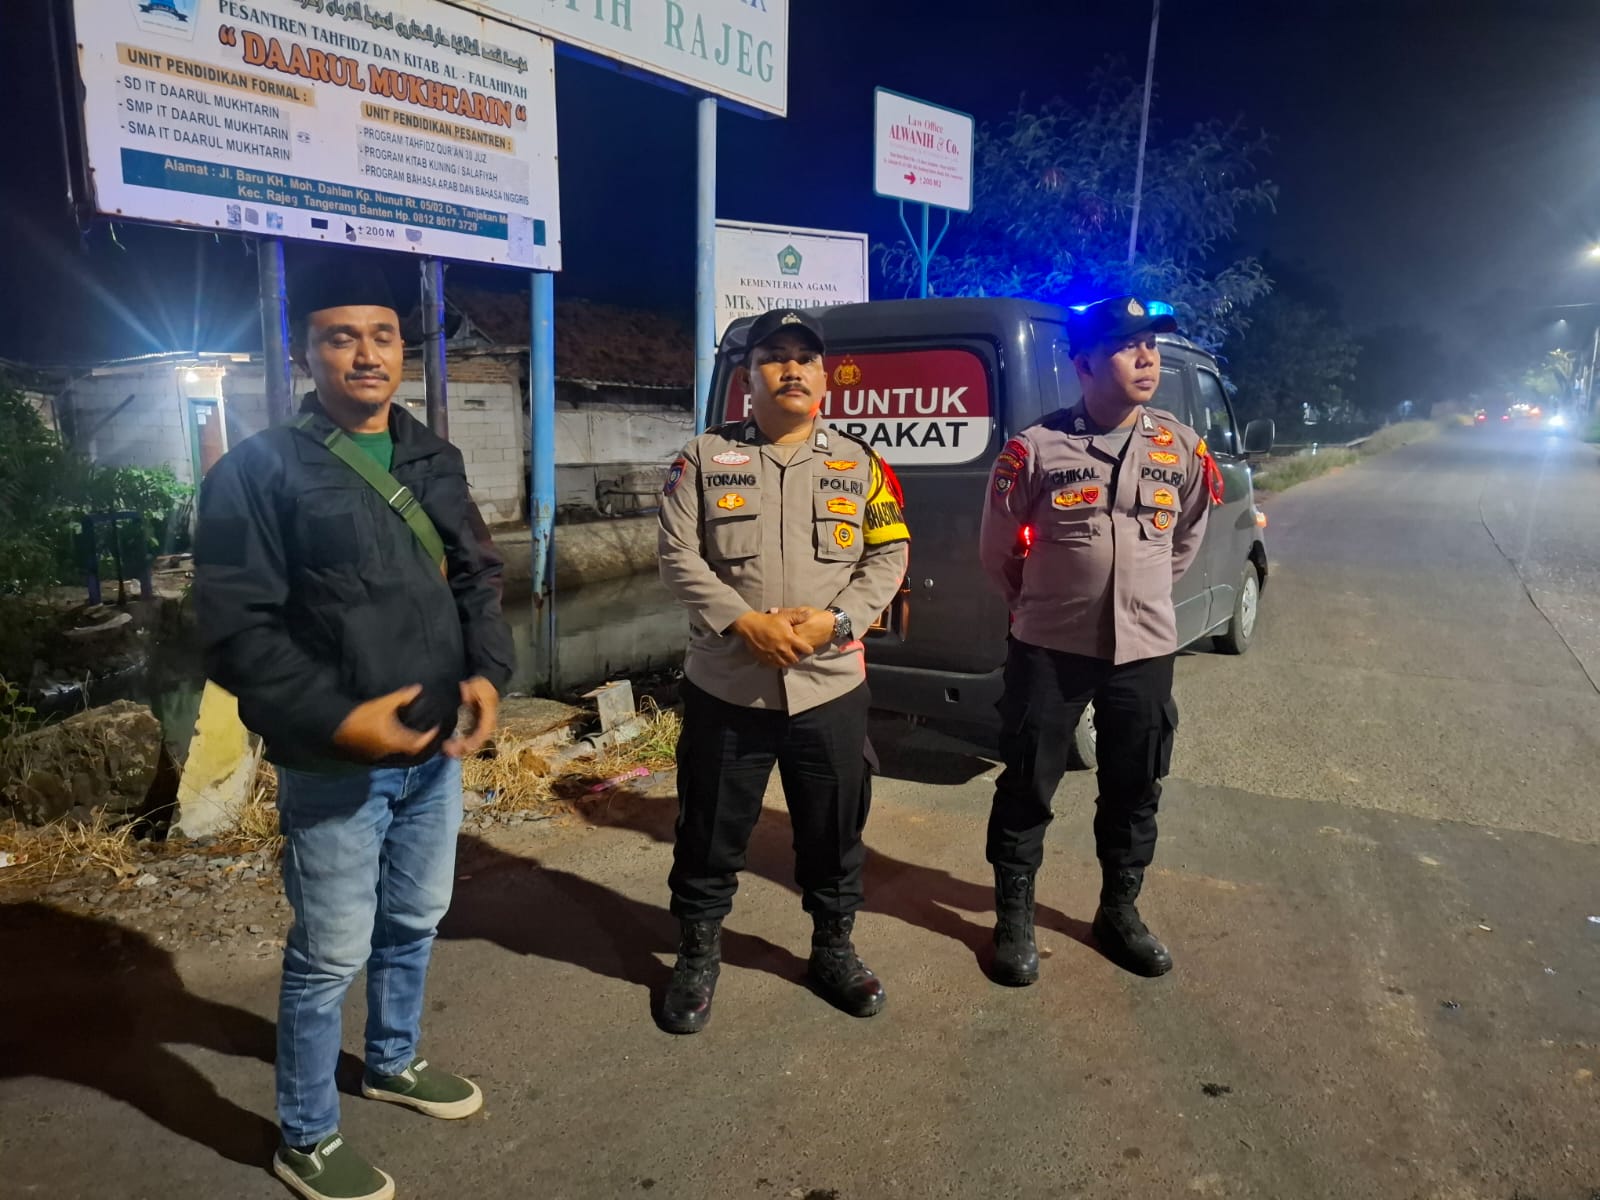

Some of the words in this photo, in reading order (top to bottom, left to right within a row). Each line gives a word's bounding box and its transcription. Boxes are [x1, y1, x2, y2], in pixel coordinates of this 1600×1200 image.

[219, 0, 306, 36] PESANTREN
[311, 26, 368, 54] TAHFIDZ
[373, 44, 400, 62] DAN
[404, 52, 439, 74] KITAB
[443, 65, 457, 79] AL
[469, 72, 527, 99] FALAHIYAH
[664, 0, 774, 83] RAJEG
[127, 48, 161, 68] UNIT
[167, 59, 247, 91] PENDIDIKAN
[252, 78, 300, 101] FORMAL
[241, 30, 365, 91] DAARUL
[368, 63, 512, 128] MUKHTARIN
[124, 75, 141, 91] SD
[145, 80, 156, 94] IT
[160, 83, 211, 105] DAARUL
[214, 95, 279, 119] MUKHTARIN
[126, 98, 153, 114] SMP
[157, 104, 167, 117] IT
[172, 107, 221, 128] DAARUL
[224, 118, 289, 141] MUKHTARIN
[366, 103, 389, 121] UNIT
[393, 111, 452, 136] PENDIDIKAN
[455, 125, 505, 149] PESANTREN
[128, 121, 156, 137] SMA
[159, 127, 169, 140] IT
[174, 129, 223, 149] DAARUL
[226, 139, 291, 160] MUKHTARIN
[364, 127, 403, 145] PROGRAM
[405, 137, 435, 152] TAHFIDZ
[164, 158, 208, 176] Alamat
[236, 169, 264, 184] Baru
[364, 145, 404, 164] PROGRAM
[405, 154, 427, 169] KITAB
[365, 164, 405, 182] PROGRAM
[406, 171, 437, 188] BAHASA
[438, 179, 458, 192] ARAB
[459, 183, 474, 195] DAN
[475, 185, 502, 200] BAHASA
[237, 185, 263, 199] Kec.
[266, 189, 298, 207] Rajeg
[304, 194, 357, 215] Tangerang
[359, 203, 393, 217] Banten
[366, 225, 384, 237] 200
[386, 229, 395, 238] M
[740, 277, 803, 290] KEMENTERIAN
[806, 283, 838, 292] AGAMA
[842, 387, 969, 415] UNTUK
[705, 474, 756, 487] TORANG
[819, 477, 863, 494] POLRI
